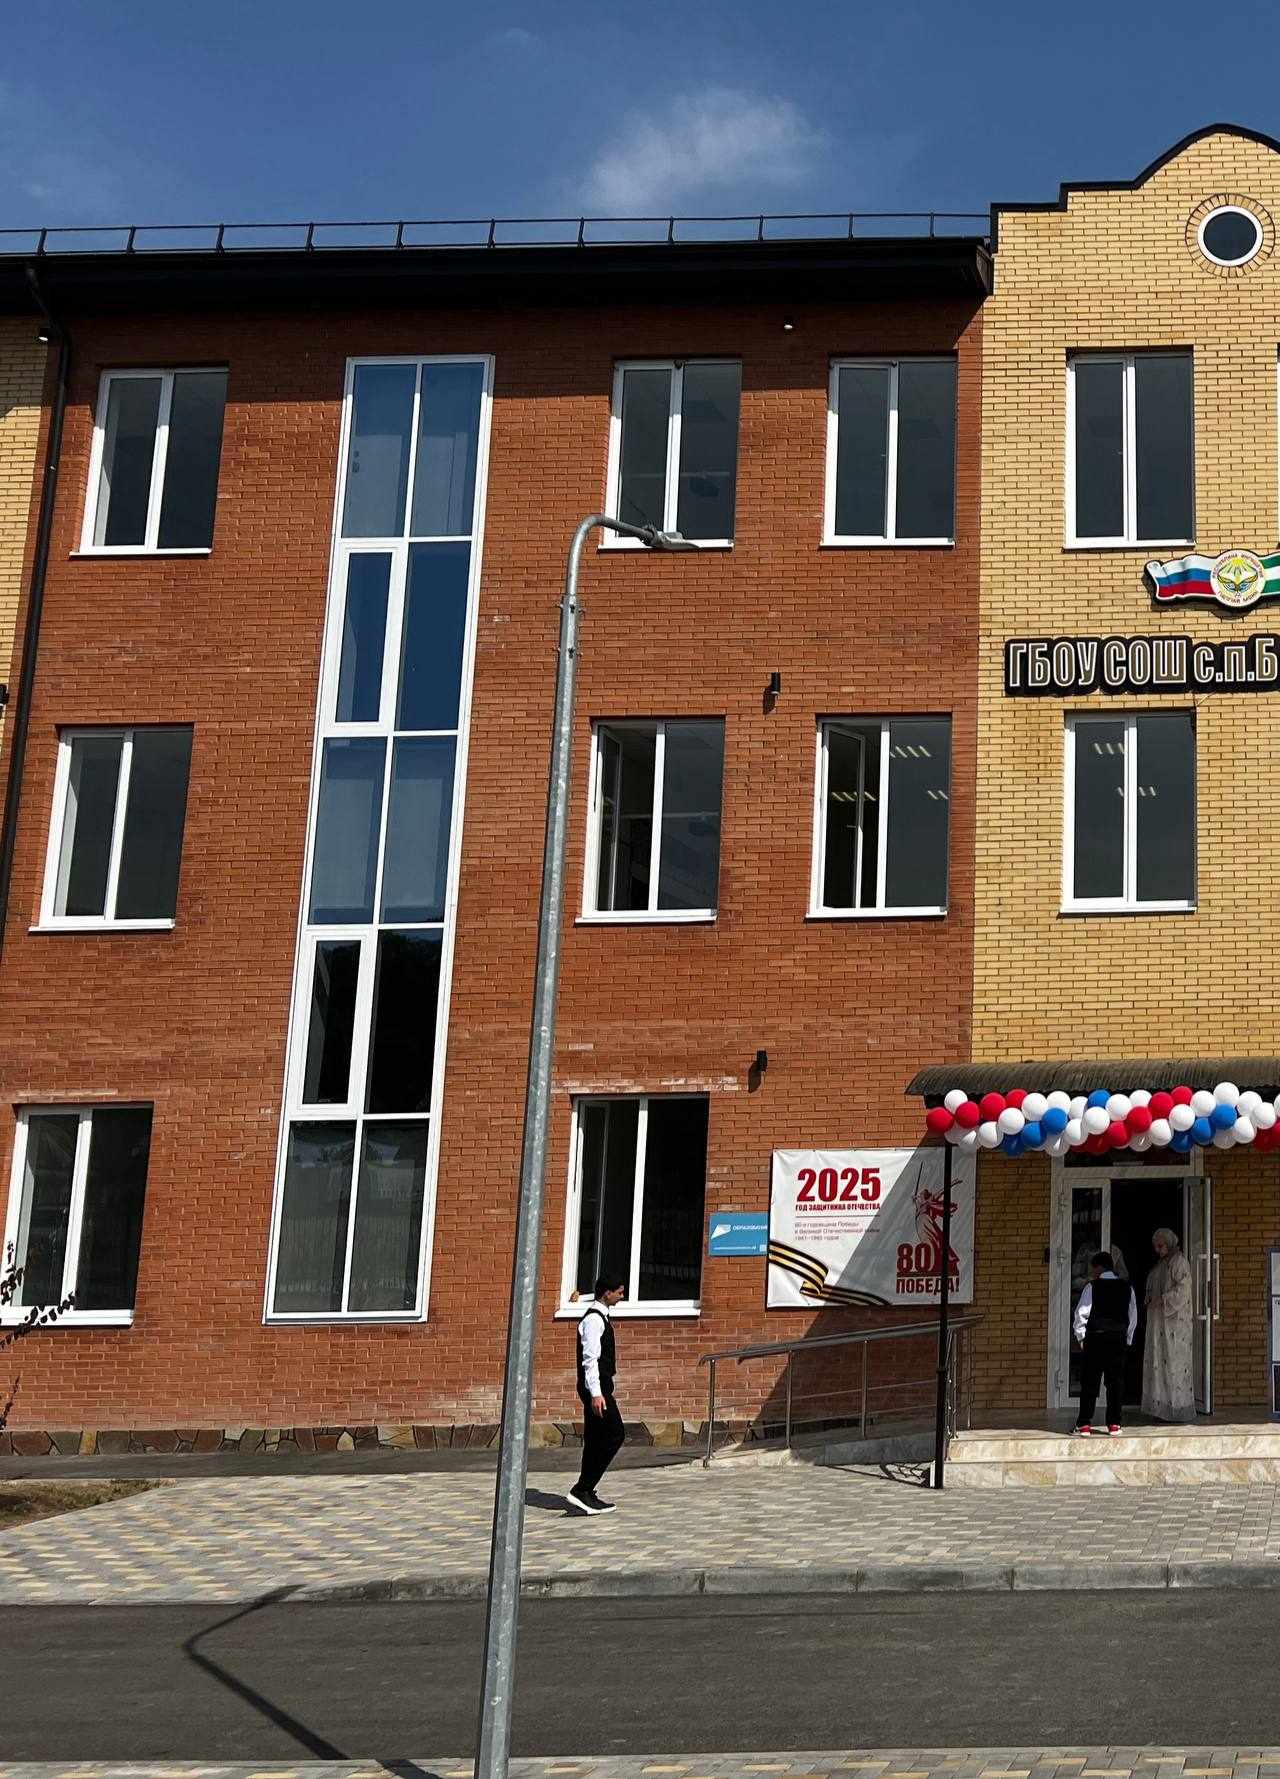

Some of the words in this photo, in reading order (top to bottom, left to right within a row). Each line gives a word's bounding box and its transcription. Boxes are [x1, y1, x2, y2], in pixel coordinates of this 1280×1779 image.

[1009, 641, 1097, 687] ГБОУ
[1103, 640, 1187, 685] СОШ
[796, 1167, 881, 1202] 2025
[795, 1203, 808, 1212] ГОД
[847, 1202, 881, 1211] ОТЕЧЕСТВА
[896, 1243, 932, 1272] 80
